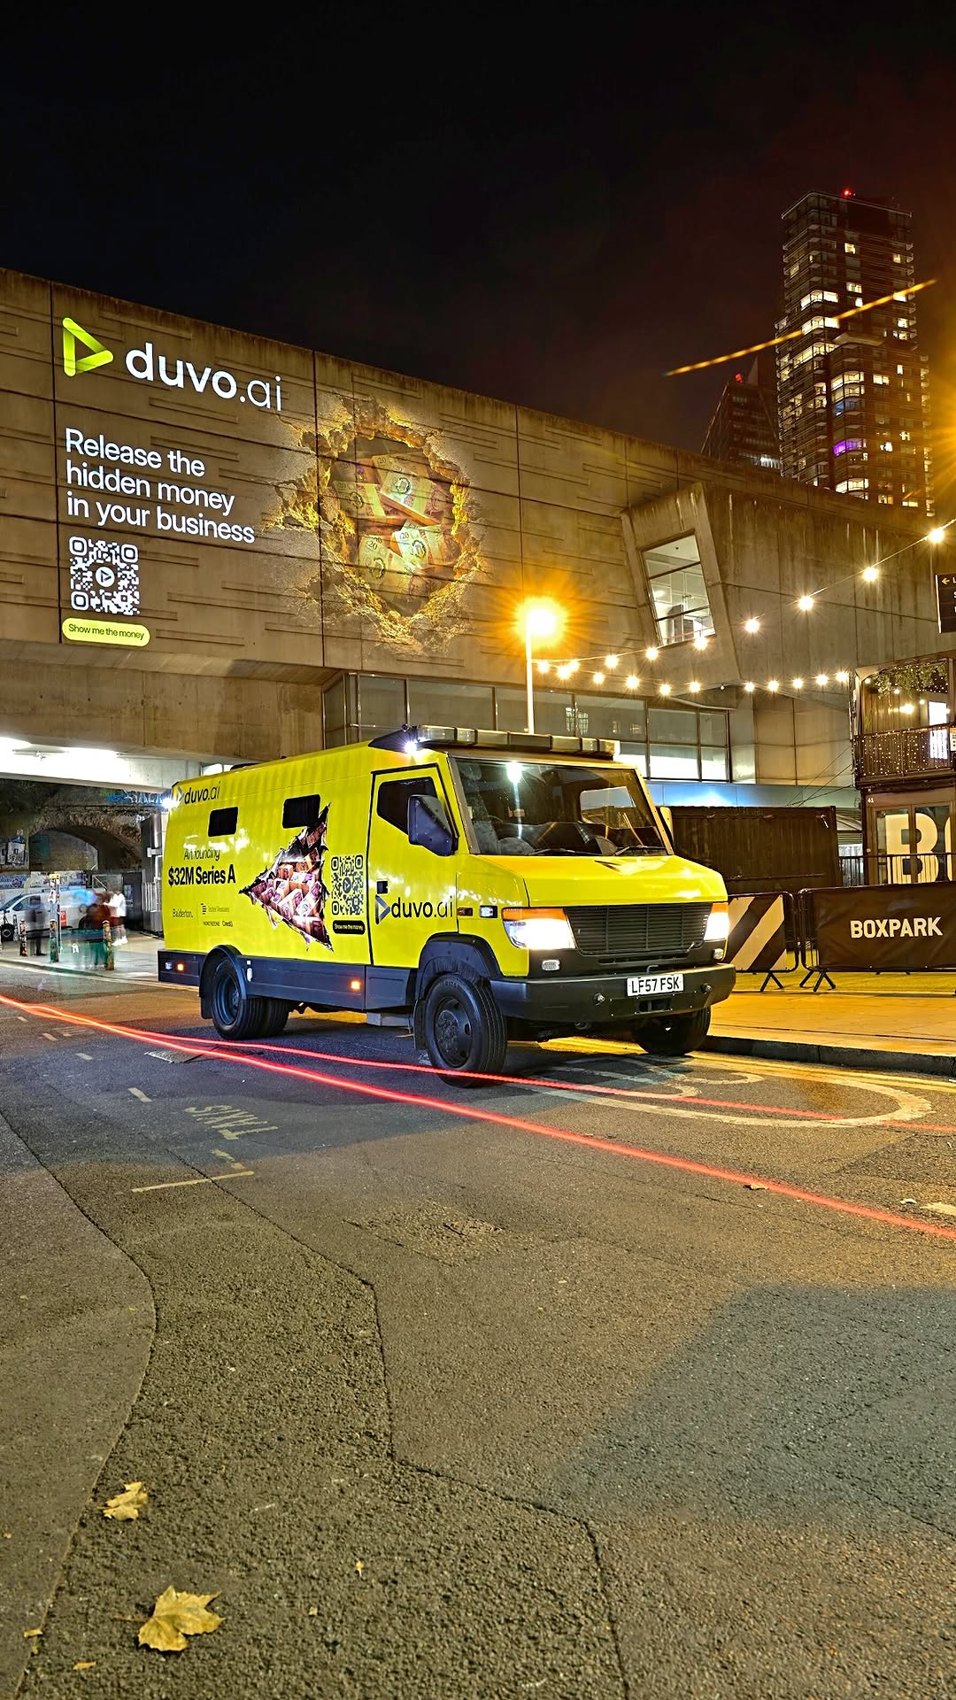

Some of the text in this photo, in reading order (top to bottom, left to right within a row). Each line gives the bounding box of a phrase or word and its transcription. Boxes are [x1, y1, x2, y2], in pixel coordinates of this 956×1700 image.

[125, 342, 282, 411] duvo.ai
[65, 428, 205, 477] Release the
[66, 460, 235, 516] hidden money
[67, 491, 256, 544] in your business
[68, 623, 91, 634] Show
[106, 628, 118, 636] the
[119, 630, 145, 640] money
[184, 781, 222, 805] duvo.ai
[168, 864, 236, 888] $32M Series A
[391, 895, 453, 918] duvo.ai
[850, 916, 943, 939] BOXPARK
[631, 976, 680, 994] LF57 FSK
